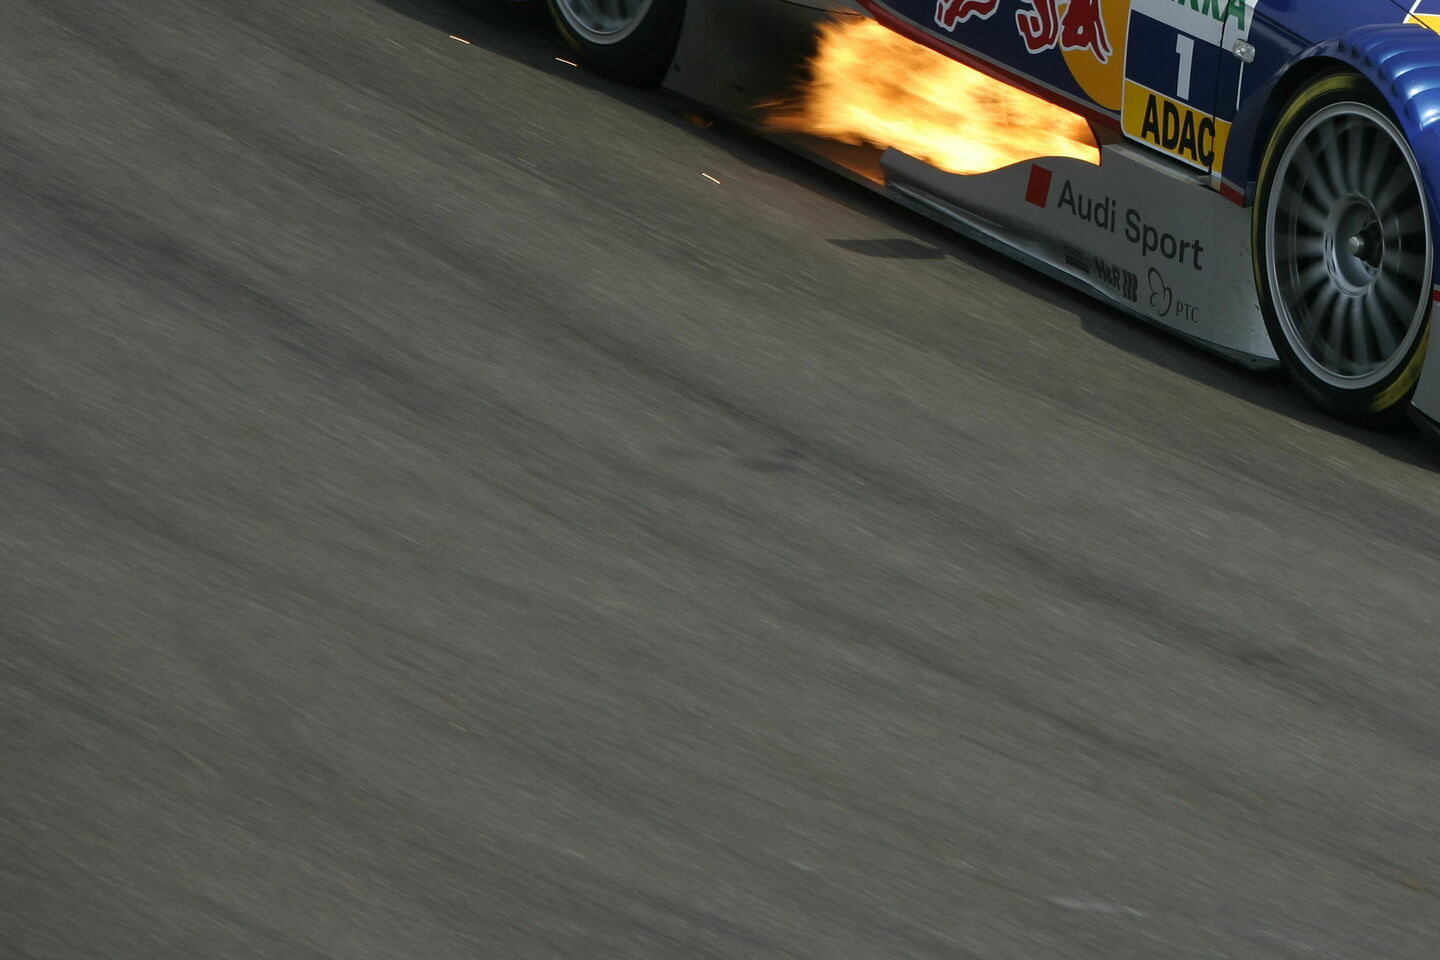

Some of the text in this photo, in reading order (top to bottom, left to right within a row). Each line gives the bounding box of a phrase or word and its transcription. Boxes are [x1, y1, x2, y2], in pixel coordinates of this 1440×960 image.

[1175, 33, 1194, 101] 1
[1141, 93, 1215, 166] ADAC
[1057, 179, 1117, 233] Audi
[1125, 208, 1204, 271] Sport
[1176, 300, 1200, 324] PTC
